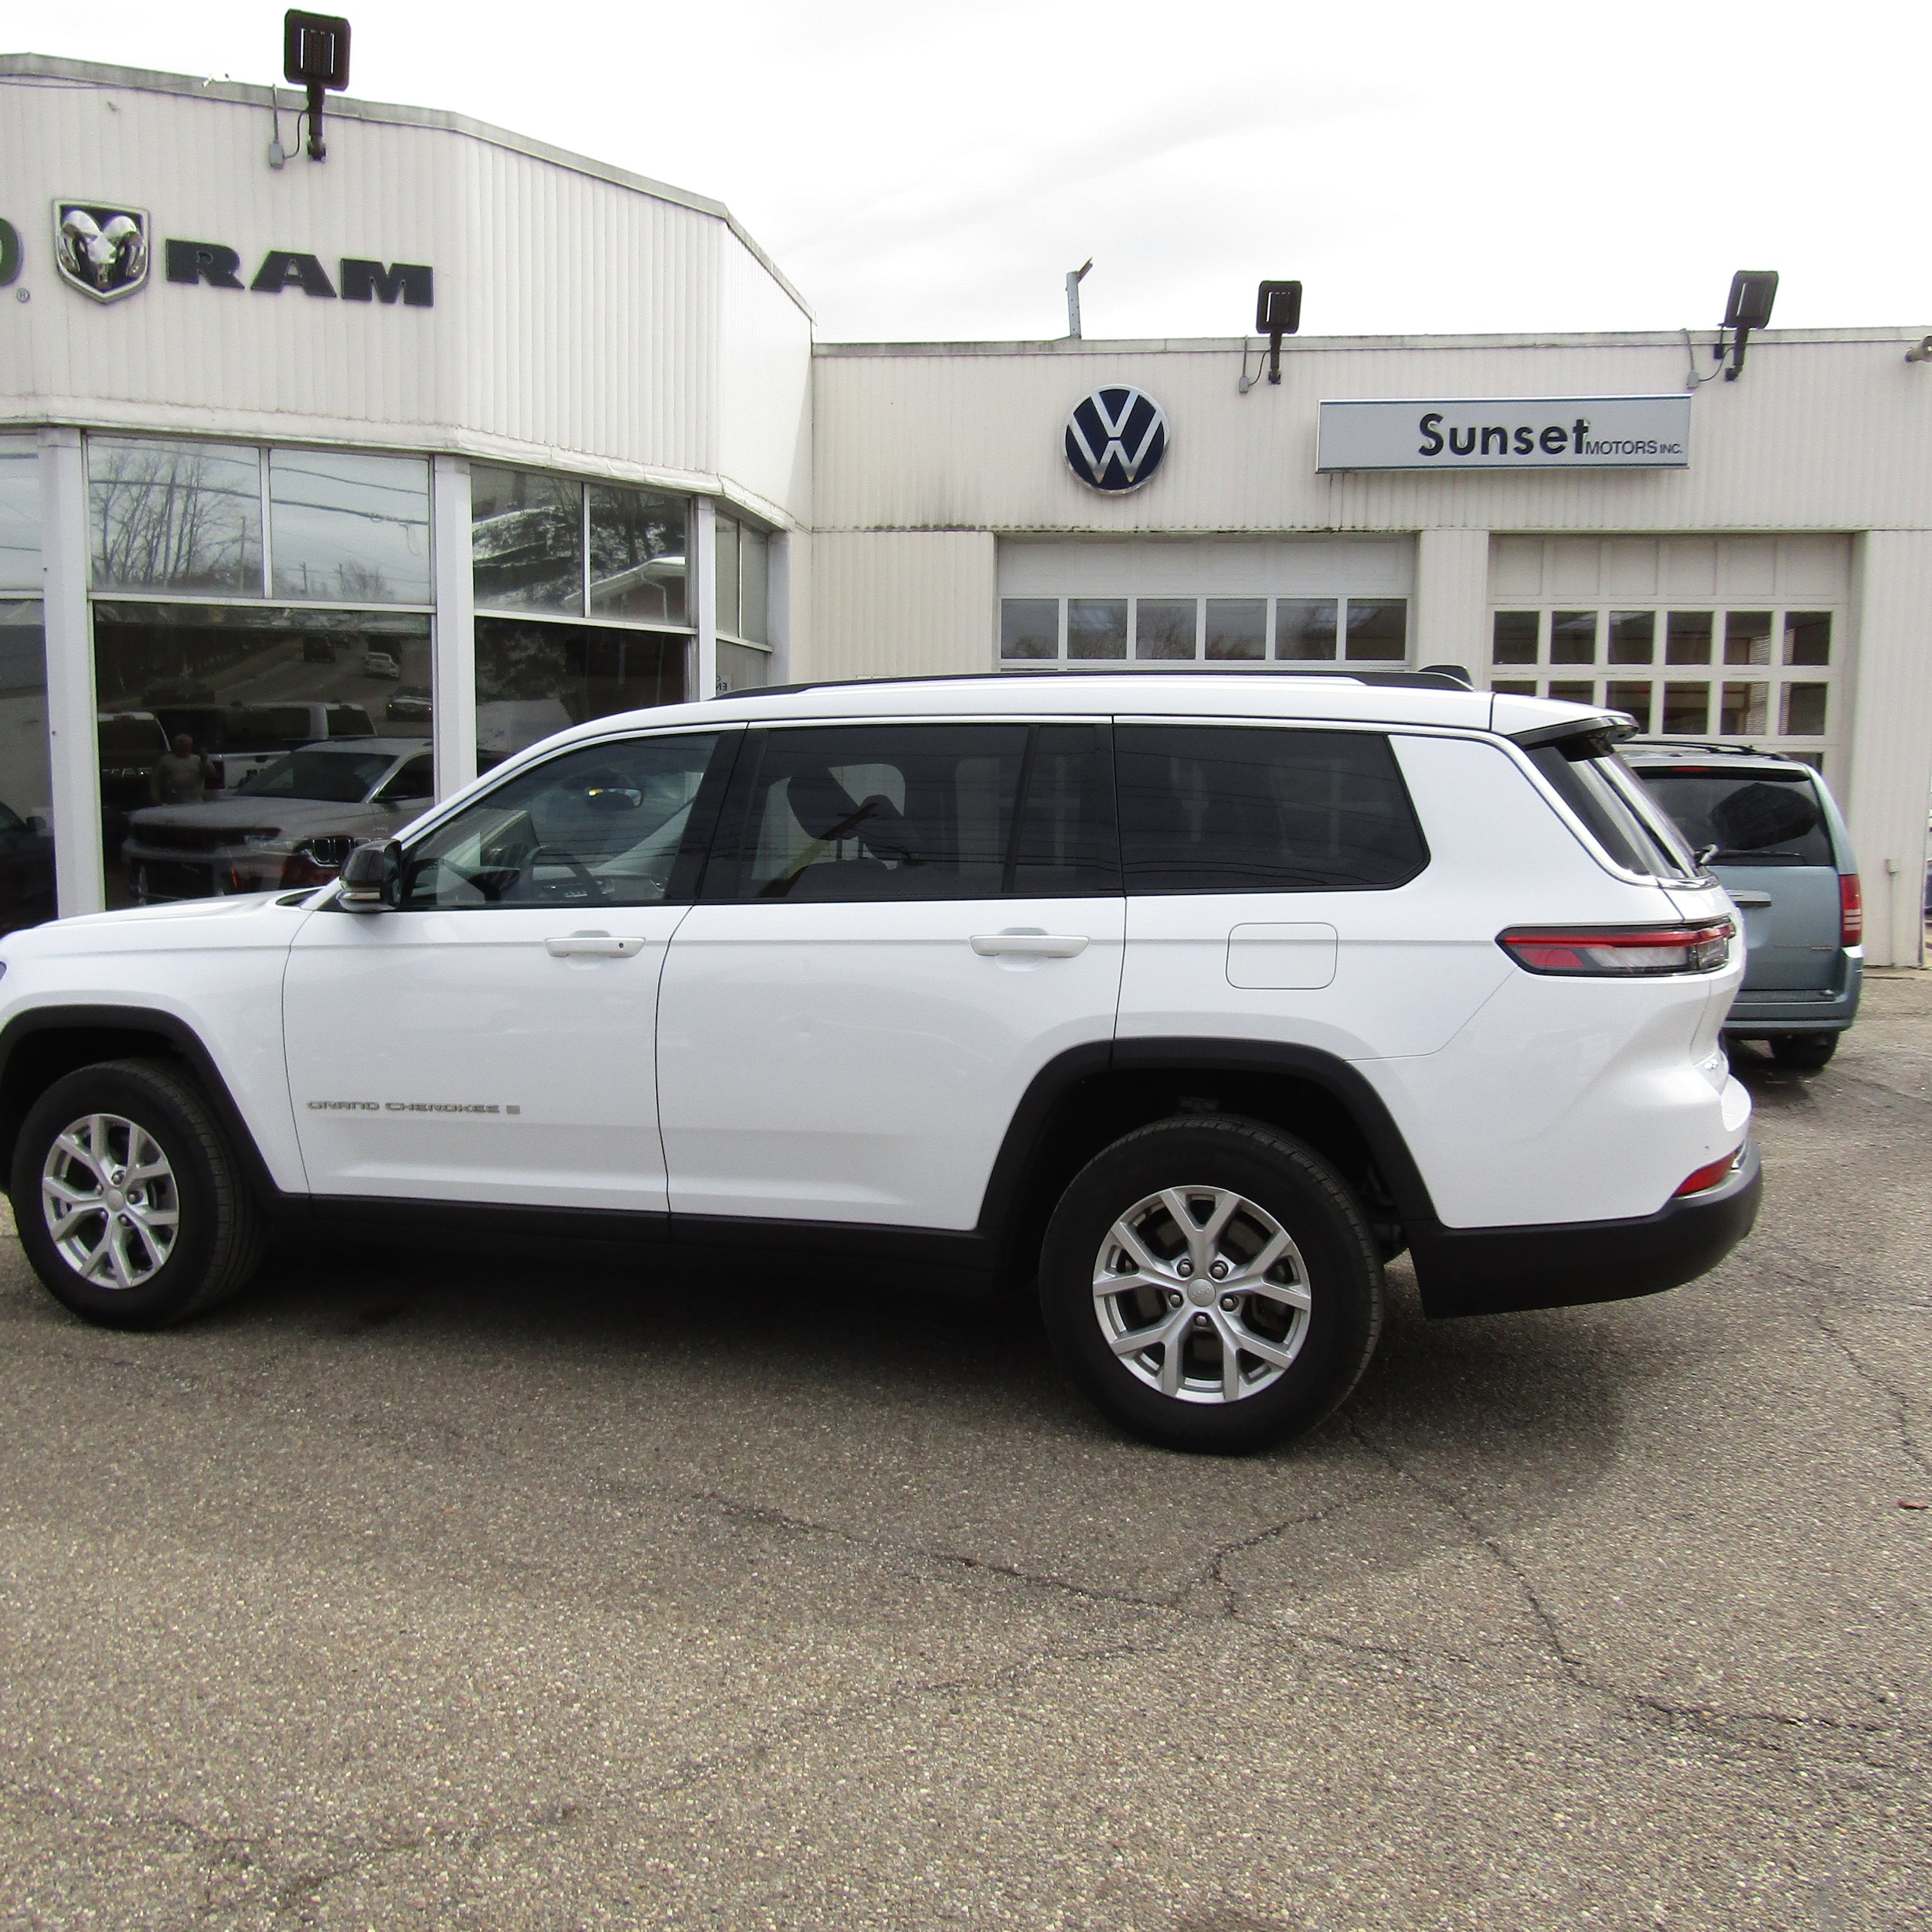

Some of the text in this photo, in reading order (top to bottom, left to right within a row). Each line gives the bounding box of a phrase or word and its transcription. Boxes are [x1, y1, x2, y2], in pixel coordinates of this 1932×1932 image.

[165, 238, 434, 307] RAM
[1066, 386, 1165, 485] VW
[1418, 413, 1684, 457] Sunset MOTORS INC.
[307, 1101, 379, 1111] GRAND
[385, 1102, 500, 1114] CHEROKEE
